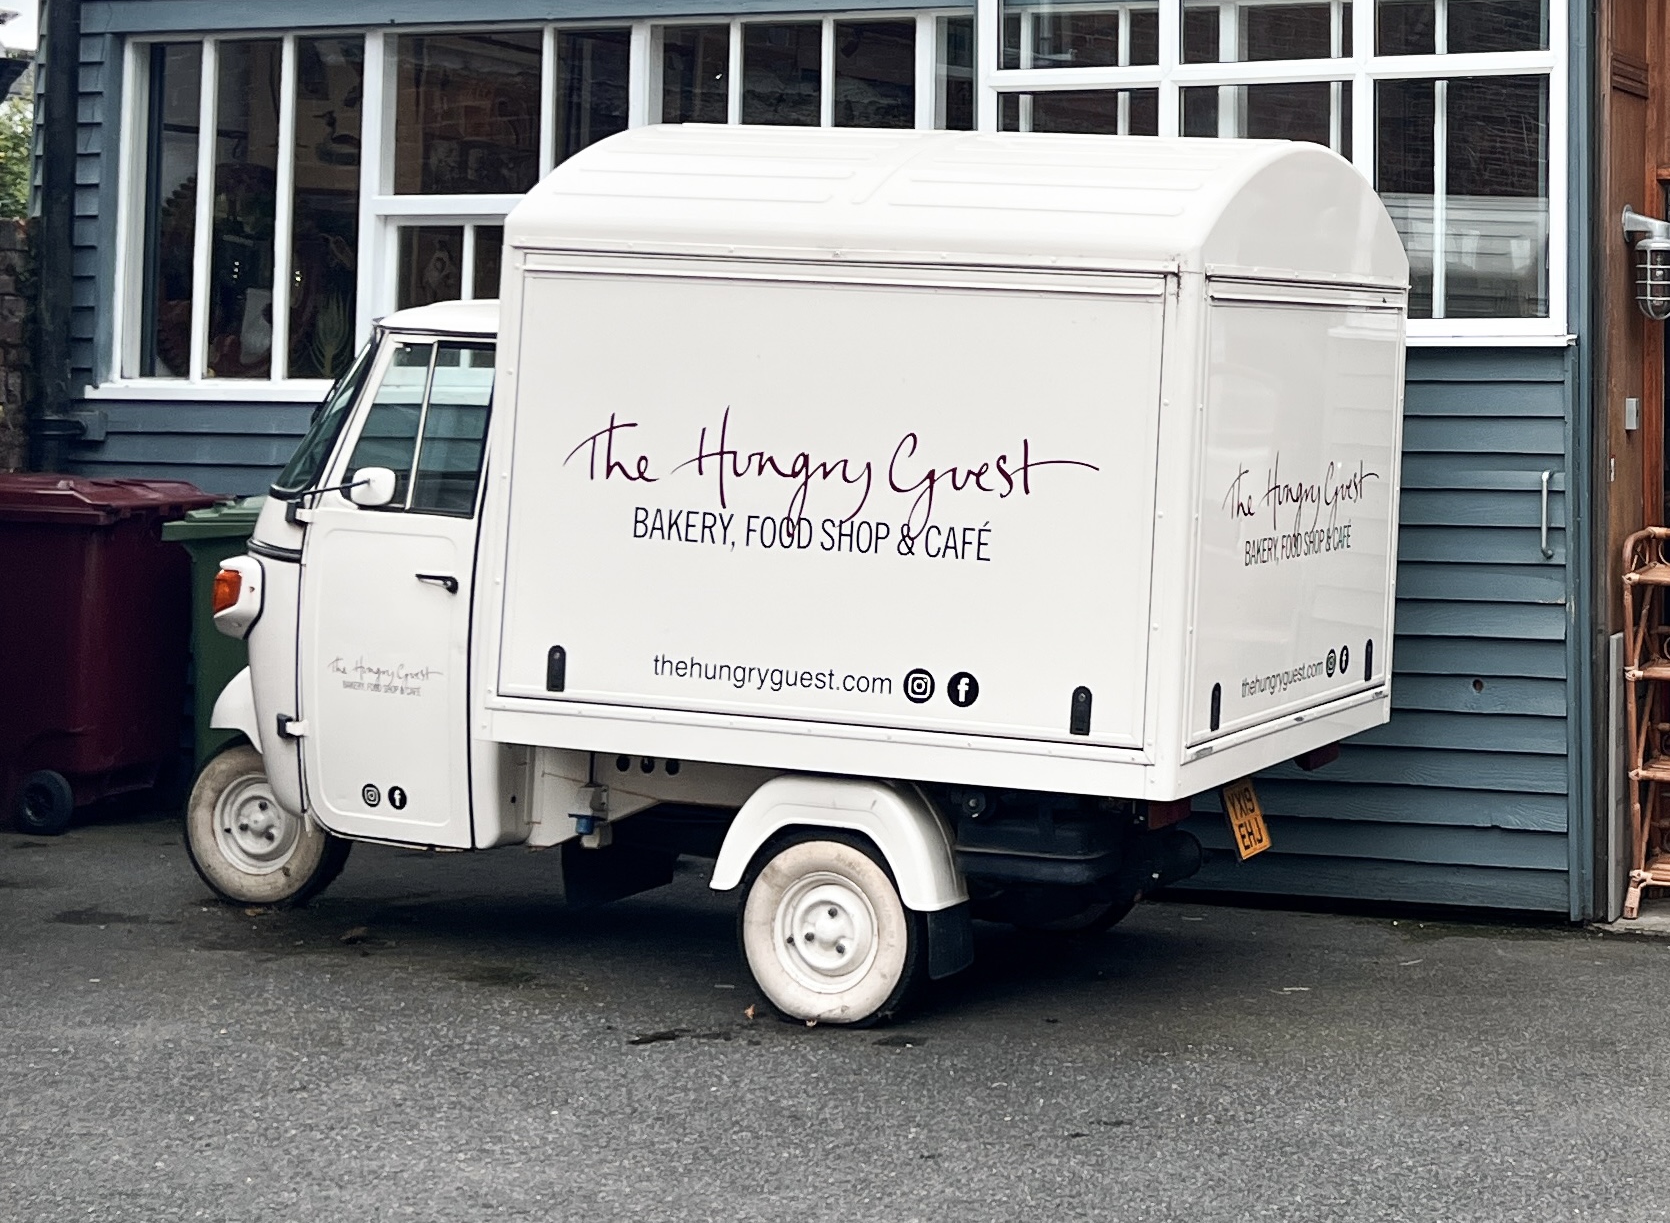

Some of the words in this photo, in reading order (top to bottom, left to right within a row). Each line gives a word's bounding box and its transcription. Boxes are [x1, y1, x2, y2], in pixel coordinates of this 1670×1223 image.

[563, 412, 659, 482] The
[671, 405, 871, 540] Hungry
[888, 432, 1099, 542] Guest
[1222, 462, 1255, 519] The
[1258, 450, 1320, 543] Hungry
[1325, 460, 1379, 535] Guest
[633, 506, 736, 552] BAKERY,
[746, 514, 813, 550] FOOD
[820, 518, 890, 554] SHOP
[896, 523, 916, 556] &
[925, 520, 993, 562] CAFÉ
[1281, 532, 1301, 560] FOOD
[1304, 529, 1325, 557] SHOP
[653, 654, 892, 694] thehungryguest.com
[1241, 661, 1323, 697] thehungryguest.com
[1238, 816, 1264, 852] EHJ
